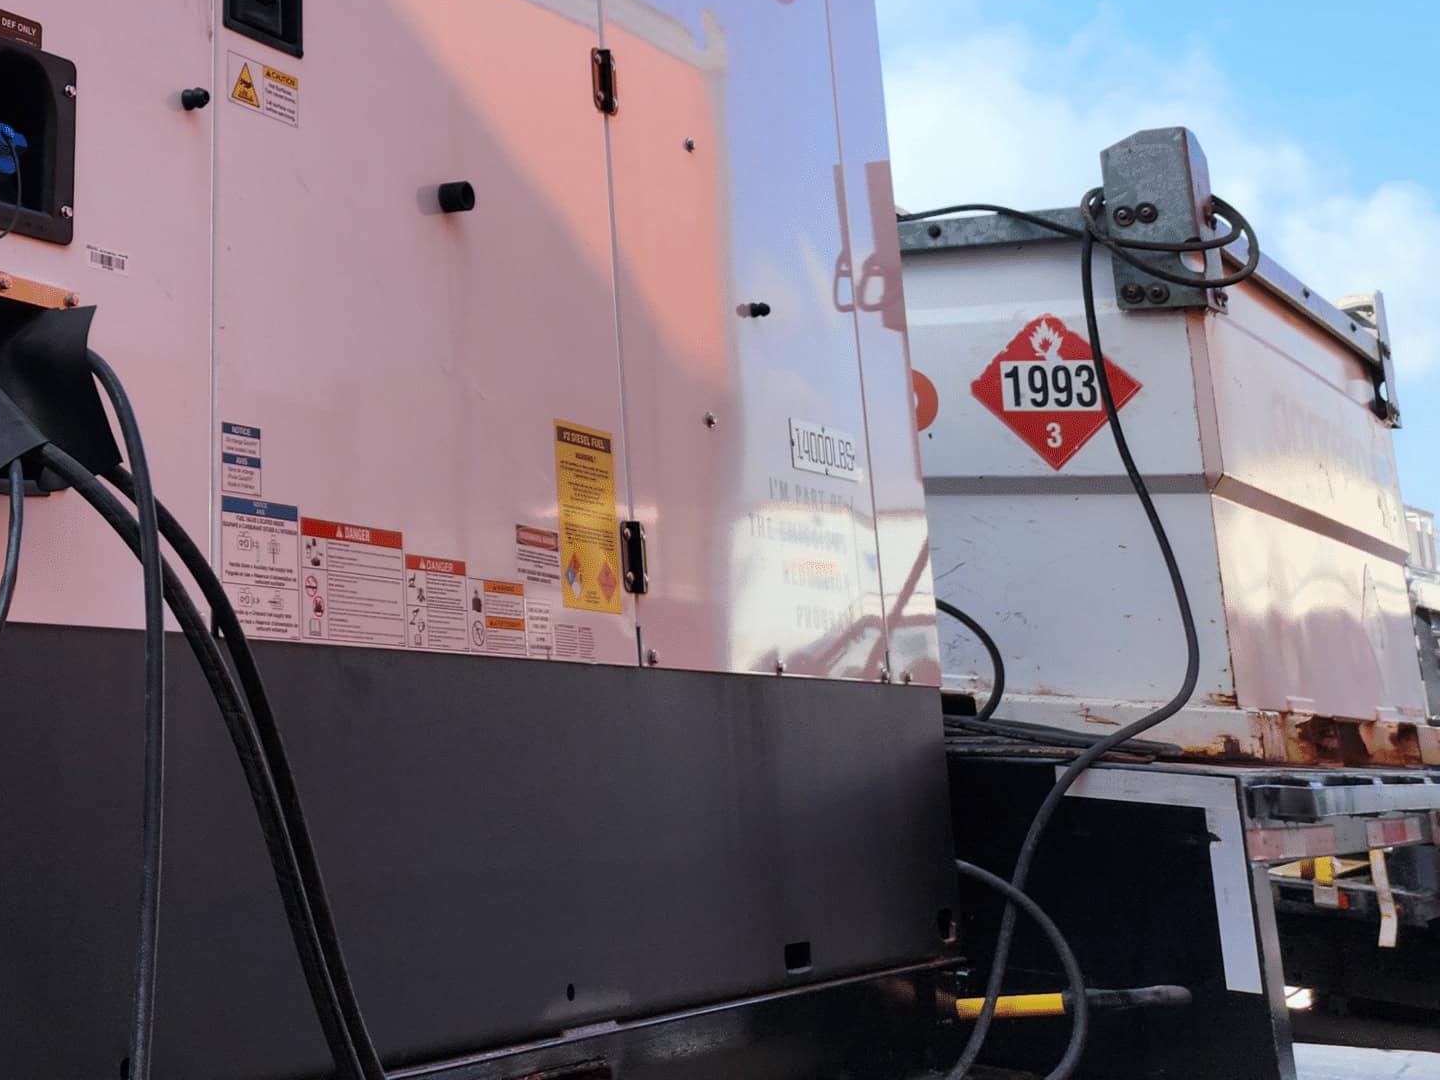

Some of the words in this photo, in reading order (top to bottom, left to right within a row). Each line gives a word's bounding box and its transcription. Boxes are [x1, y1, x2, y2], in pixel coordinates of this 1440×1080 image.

[1, 16, 17, 30] DEF
[17, 23, 37, 37] ONLY
[271, 71, 295, 86] CAUTION
[1003, 364, 1099, 409] 1993
[1045, 422, 1063, 449] 3
[344, 526, 370, 542] DANGER
[427, 559, 454, 571] DANGER
